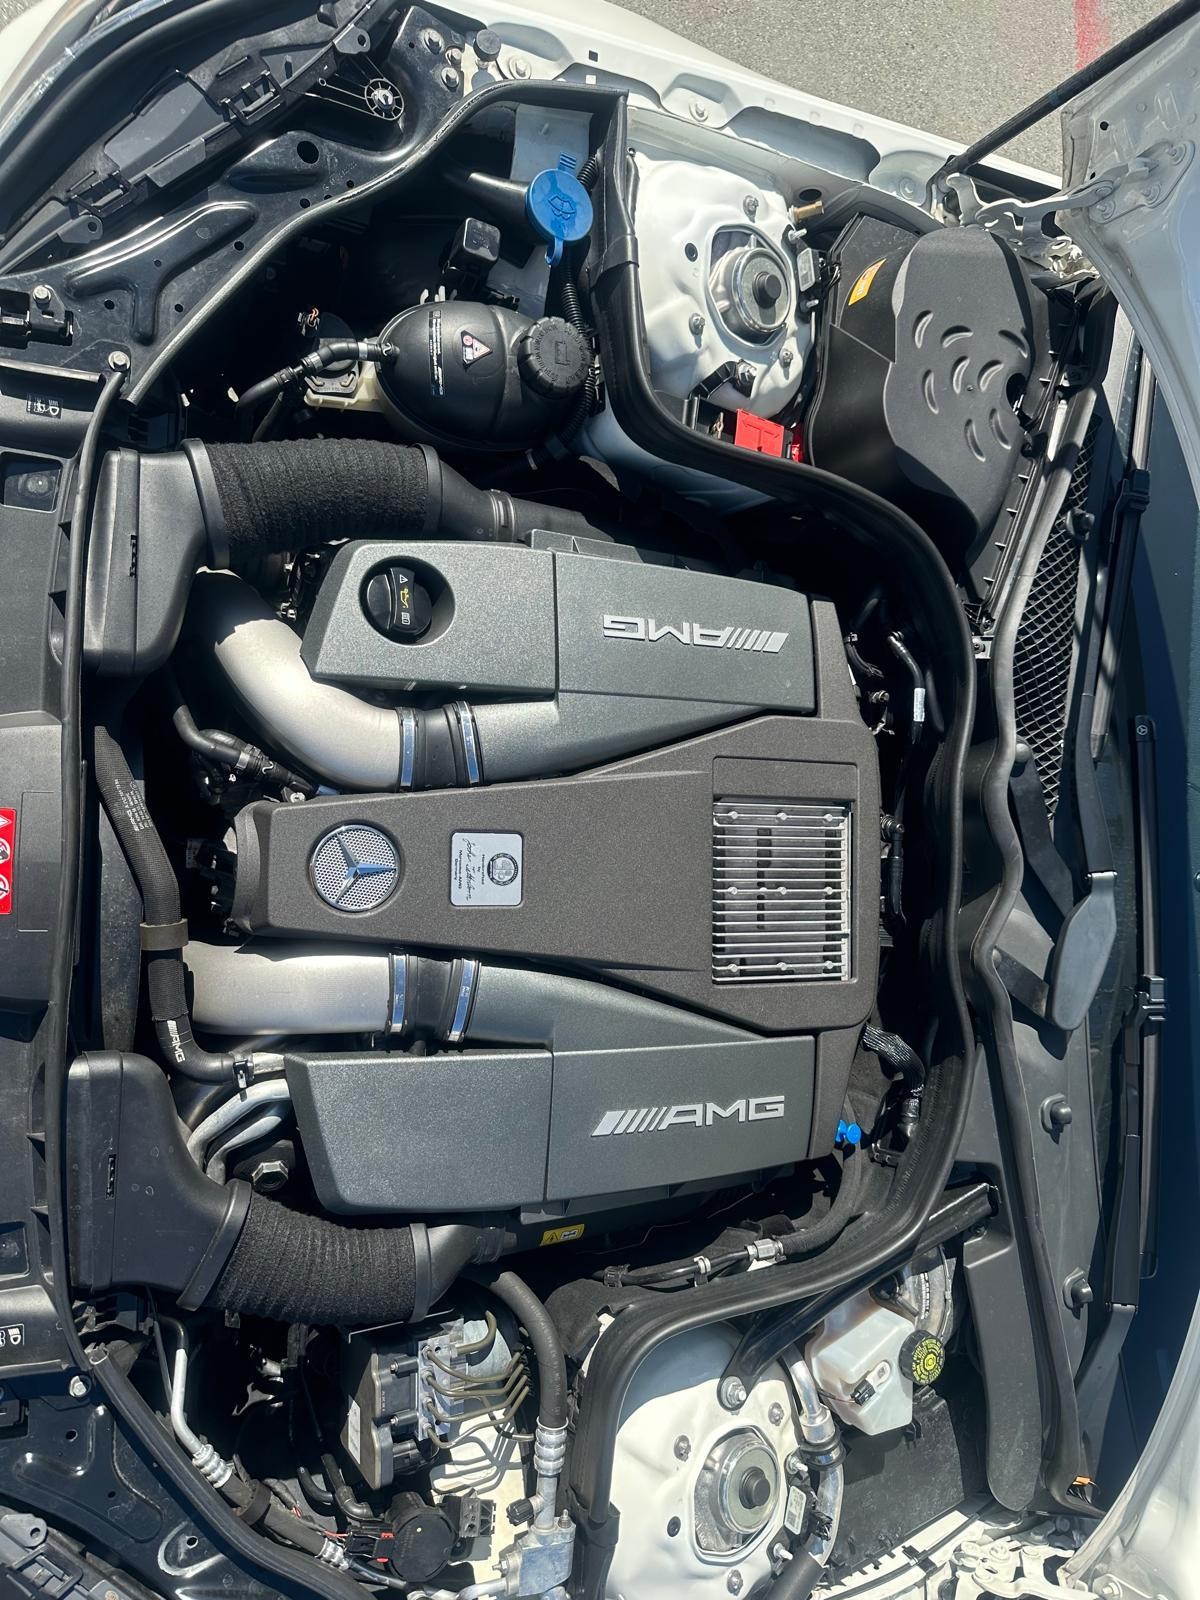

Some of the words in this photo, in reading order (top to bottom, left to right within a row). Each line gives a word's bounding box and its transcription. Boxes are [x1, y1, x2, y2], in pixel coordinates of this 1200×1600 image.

[603, 615, 736, 649] AMG
[170, 1033, 186, 1063] AMG
[655, 1095, 786, 1132] AMG
